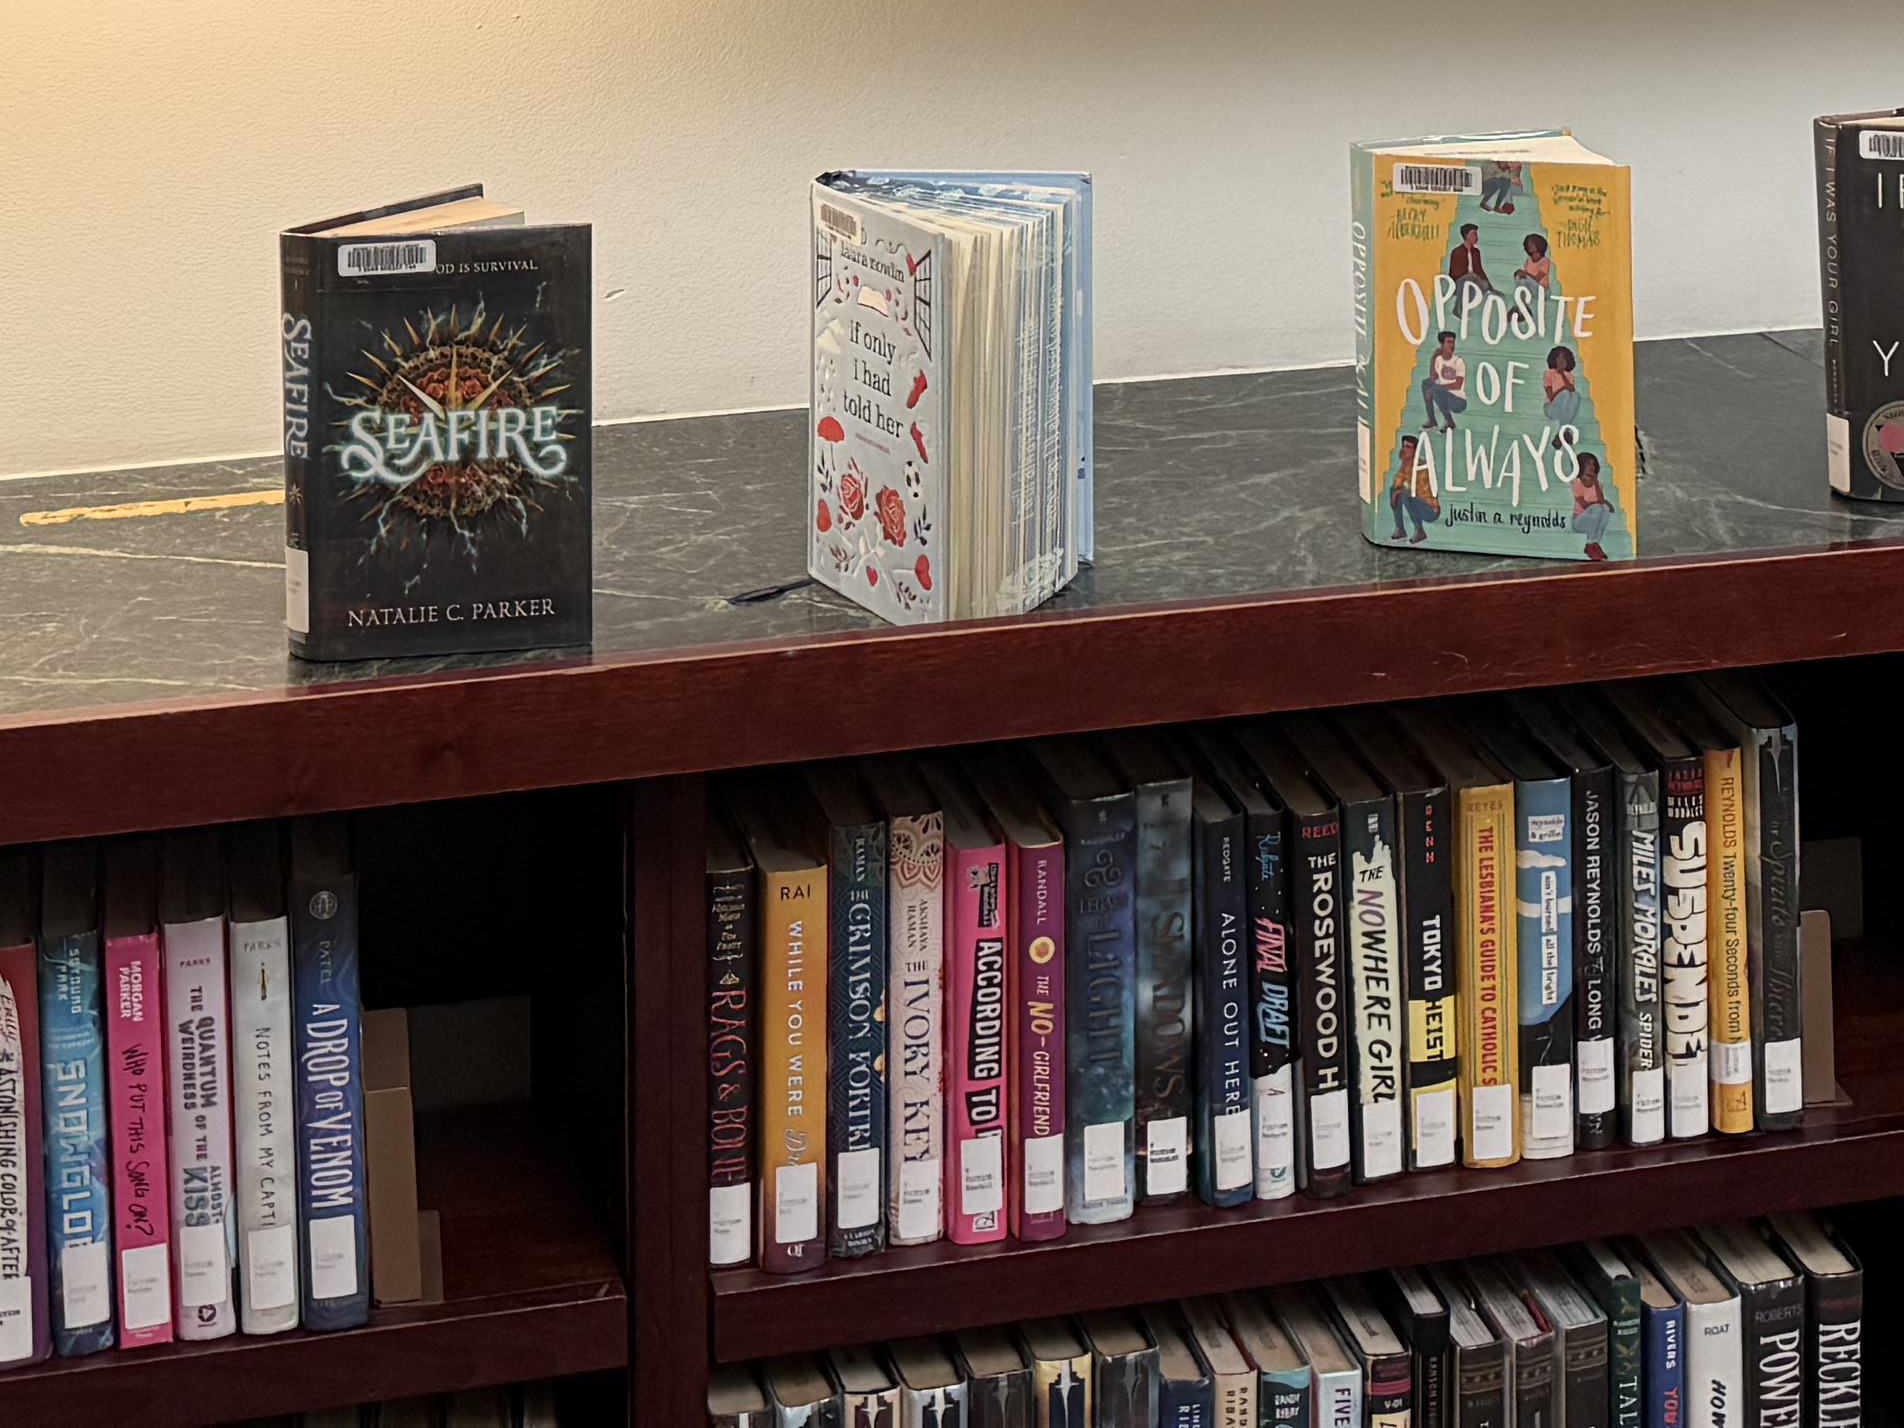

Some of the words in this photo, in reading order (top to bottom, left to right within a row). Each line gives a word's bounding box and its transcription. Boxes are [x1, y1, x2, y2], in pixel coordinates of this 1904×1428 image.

[473, 259, 538, 272] SURVIVAL
[849, 319, 861, 346] if
[863, 329, 897, 366] only
[1396, 274, 1596, 345] OPPOSITE
[862, 361, 891, 397] had
[1476, 360, 1530, 413] OF
[340, 405, 568, 485] SEAFIRE
[842, 392, 872, 426] told
[876, 407, 904, 440] her
[1410, 424, 1580, 507] ALWAYS
[349, 604, 439, 628] NATALIE
[472, 597, 556, 619] PARKER
[780, 884, 811, 901] RAI
[1036, 860, 1047, 925] RANDALL
[1587, 855, 1601, 954] REYNOLDS
[788, 920, 803, 991] WHILE
[1221, 913, 1238, 991] ALONE
[1312, 872, 1338, 1059] ROSEWOOD
[1356, 889, 1390, 1031] NOWHERE
[1422, 915, 1442, 991] TOKYO
[119, 966, 131, 1018] PARKER
[130, 960, 143, 1022] MORGAN
[787, 999, 803, 1046] YOU
[973, 940, 1002, 1081] ACCORDING
[306, 1015, 349, 1089] DROP
[902, 977, 932, 1084] IVORY
[788, 1055, 803, 1117] WERE
[308, 1112, 354, 1207] VENOM
